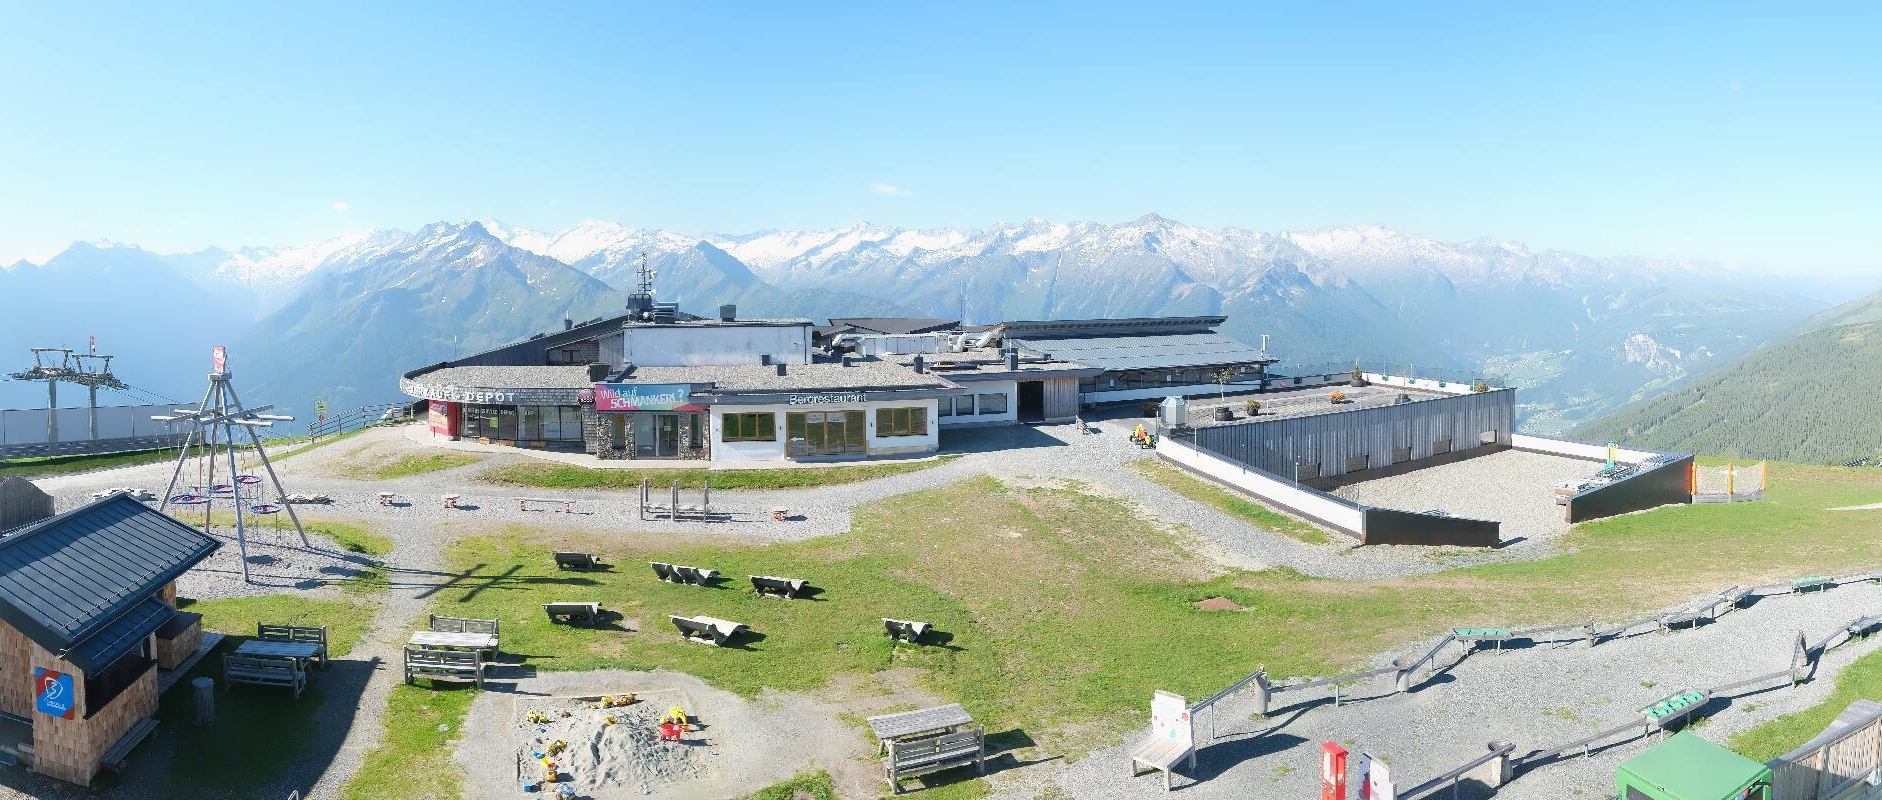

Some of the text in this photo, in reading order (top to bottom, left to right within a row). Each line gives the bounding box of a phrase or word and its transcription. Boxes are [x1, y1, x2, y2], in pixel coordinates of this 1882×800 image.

[466, 391, 515, 403] DEPOT
[601, 387, 638, 399] Wild auf
[789, 393, 867, 406] Bergrestaurant
